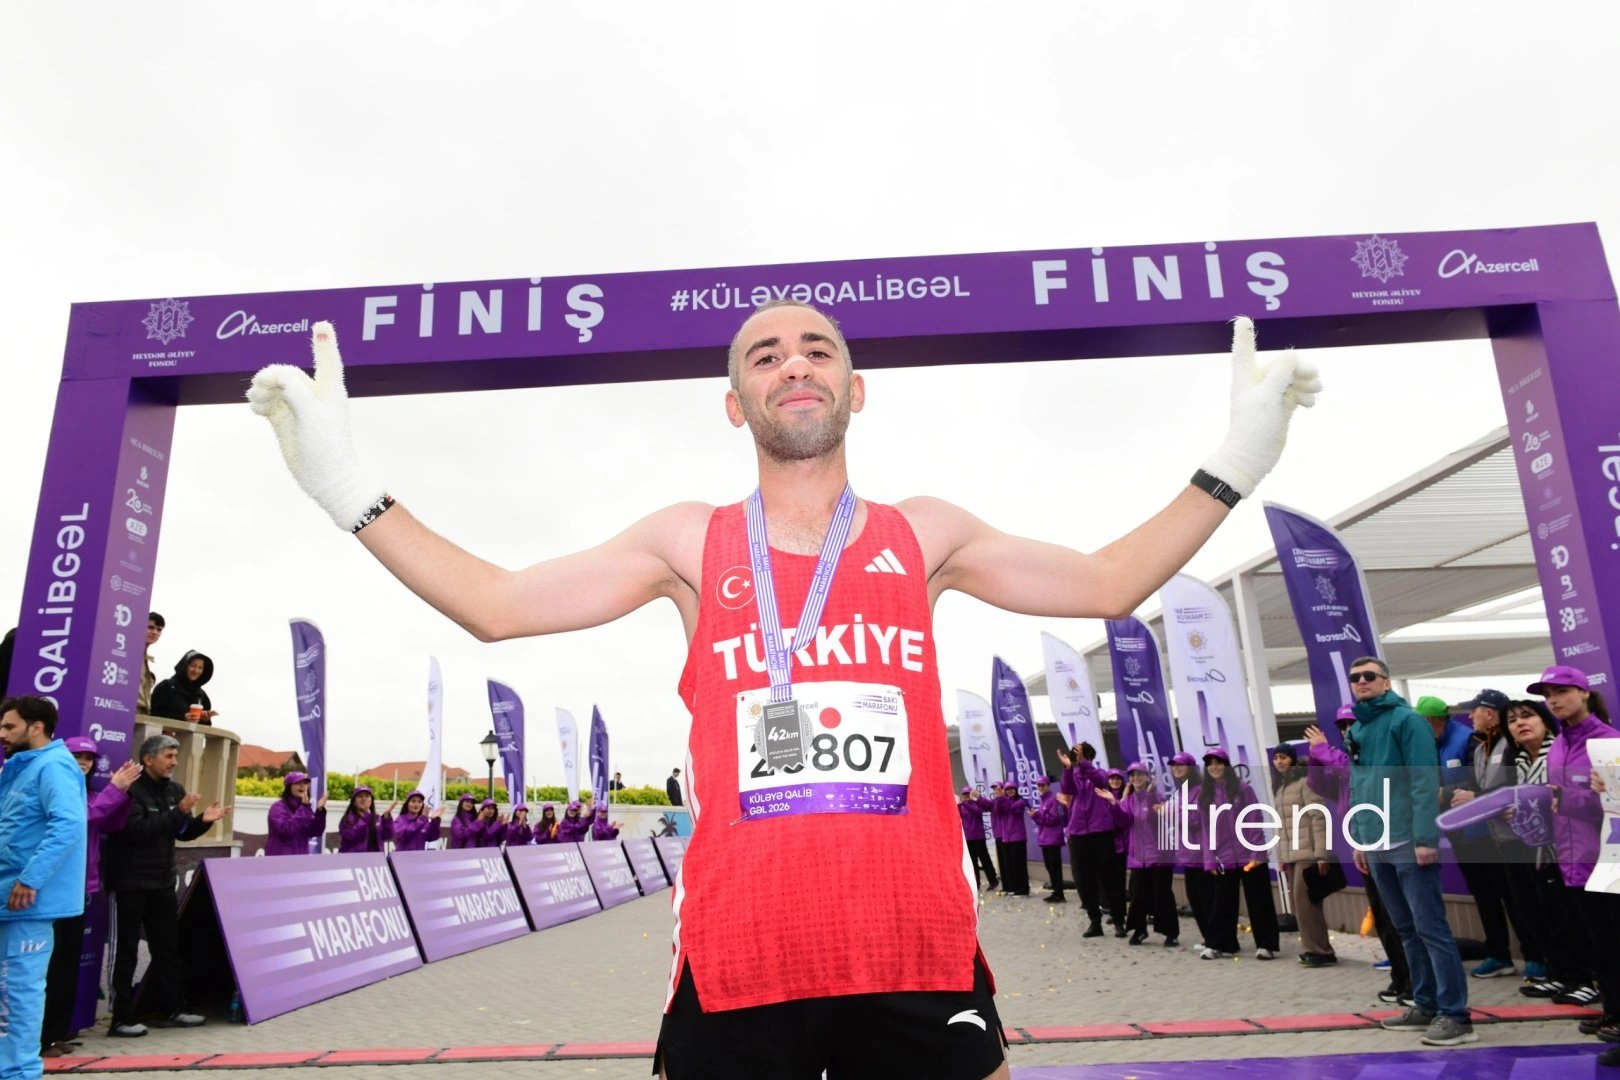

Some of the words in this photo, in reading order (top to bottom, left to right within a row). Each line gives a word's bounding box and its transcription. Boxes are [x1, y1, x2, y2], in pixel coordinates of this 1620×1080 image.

[1032, 241, 1289, 311] FİNİŞ
[1474, 258, 1540, 274] Azercell
[669, 273, 971, 311] #KÜLƏYƏQALİBGƏL
[1372, 298, 1404, 306] FONDU
[362, 276, 605, 343] FİNİŞ
[249, 318, 309, 335] Azercell
[1534, 456, 1549, 470] AZE
[129, 520, 144, 534] AZE
[818, 562, 832, 593] MARATHON
[34, 502, 89, 710] QALİBGƏL
[767, 634, 777, 670] MARATHON
[1562, 645, 1580, 658] TAN
[94, 696, 111, 709] TAN
[862, 702, 898, 711] MARAFONU
[749, 731, 895, 778] 2807
[749, 791, 784, 805] KÜLƏYƏ
[784, 787, 813, 799] QALİB
[749, 805, 768, 816] GƏL
[768, 802, 790, 813] 2026
[354, 865, 397, 902] BAKI
[481, 856, 510, 883] BAKI
[549, 875, 594, 904] MARAFONU
[455, 886, 521, 924] MARAFONU
[308, 905, 410, 960] MARAFONU
